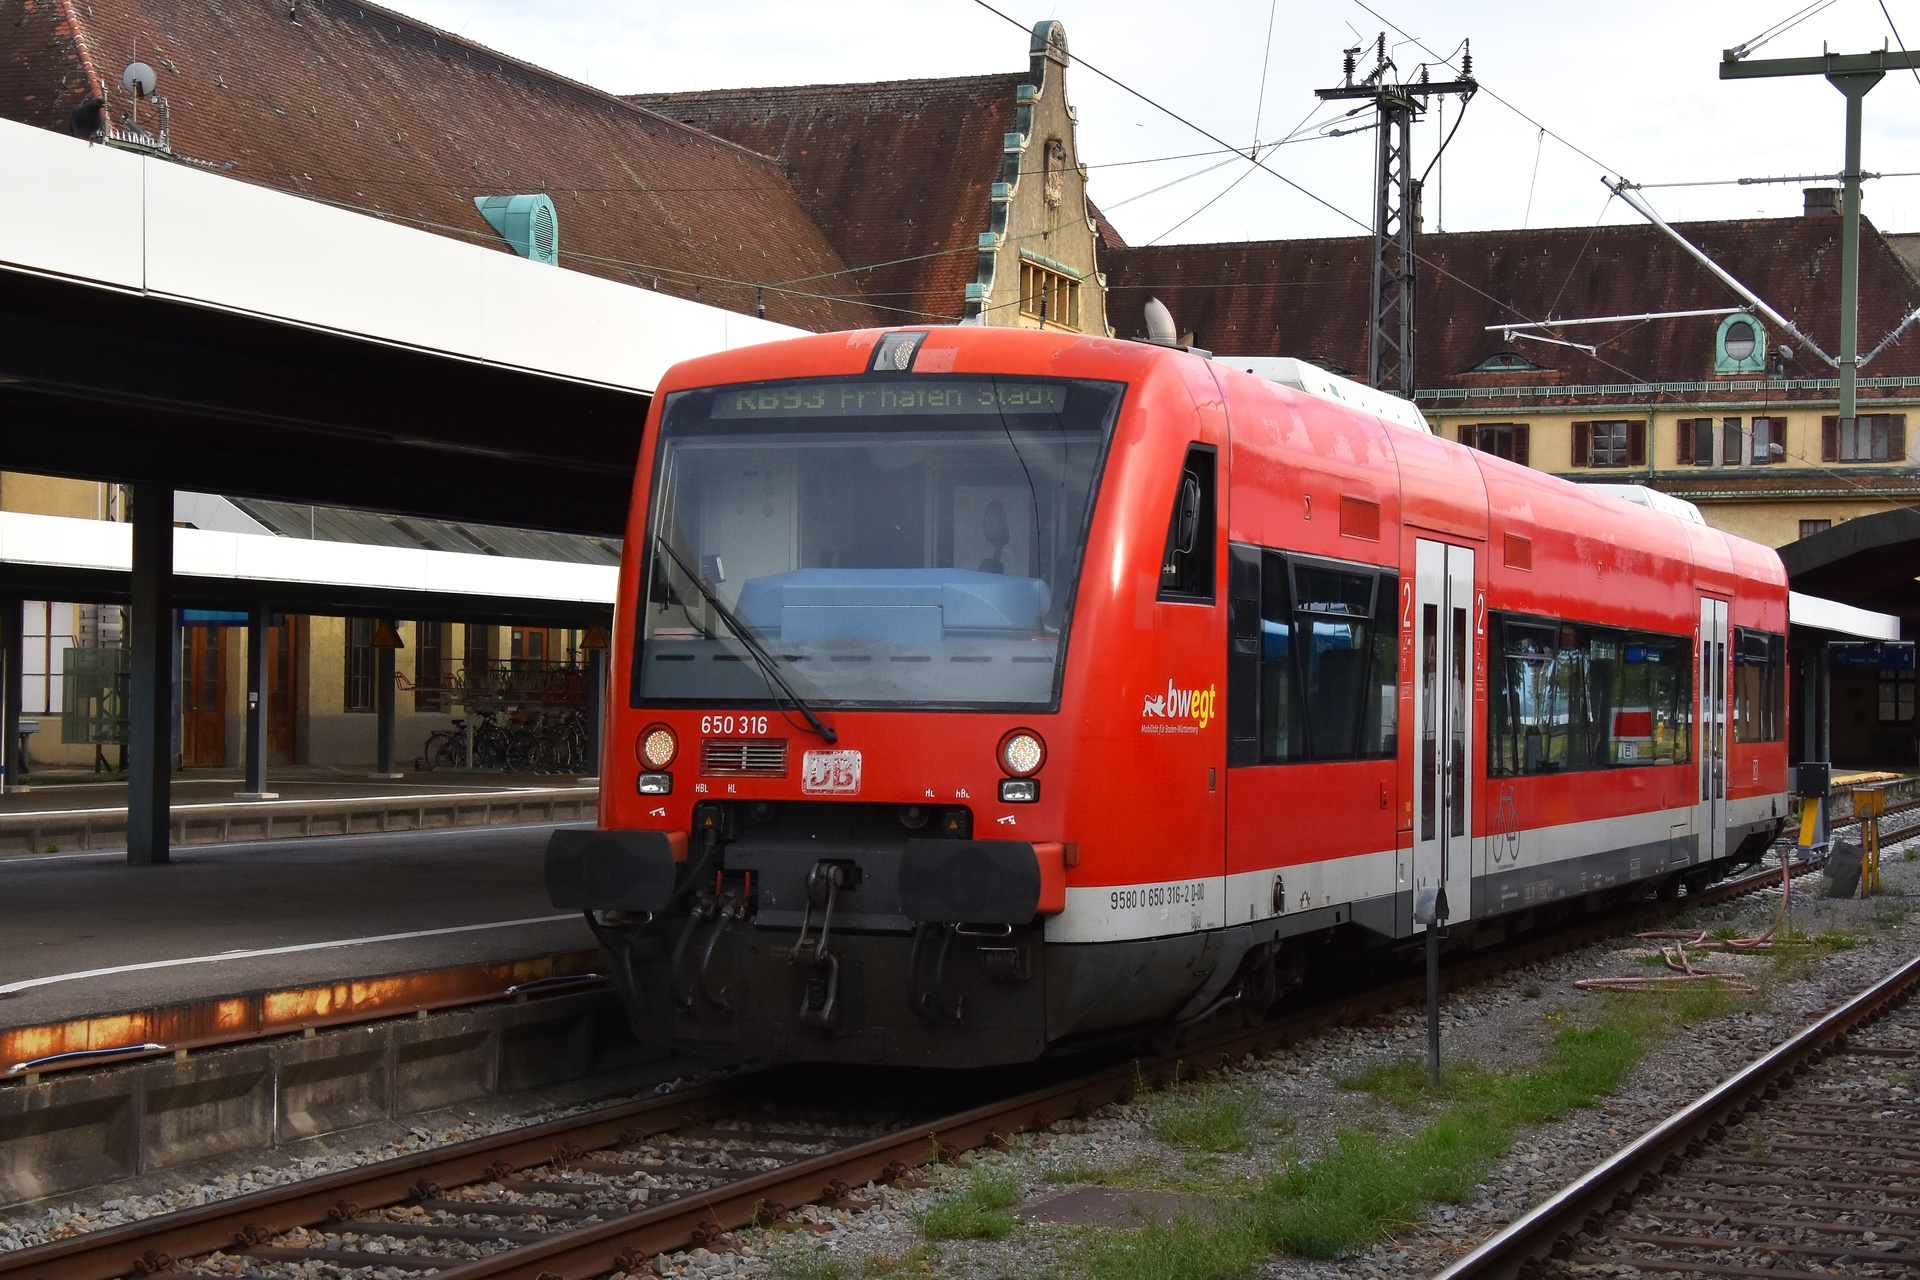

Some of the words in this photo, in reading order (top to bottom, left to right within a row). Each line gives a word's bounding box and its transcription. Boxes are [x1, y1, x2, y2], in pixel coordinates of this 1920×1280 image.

[1403, 582, 1411, 628] 2
[1477, 593, 1484, 635] 2
[1166, 678, 1216, 729] bwegt
[701, 715, 734, 734] 650
[738, 715, 768, 734] 316
[810, 756, 854, 788] DB
[695, 783, 709, 794] HBL
[727, 783, 737, 794] HL
[1140, 889, 1146, 907] 0
[1148, 887, 1165, 907] 650
[1166, 885, 1189, 905] 316-2
